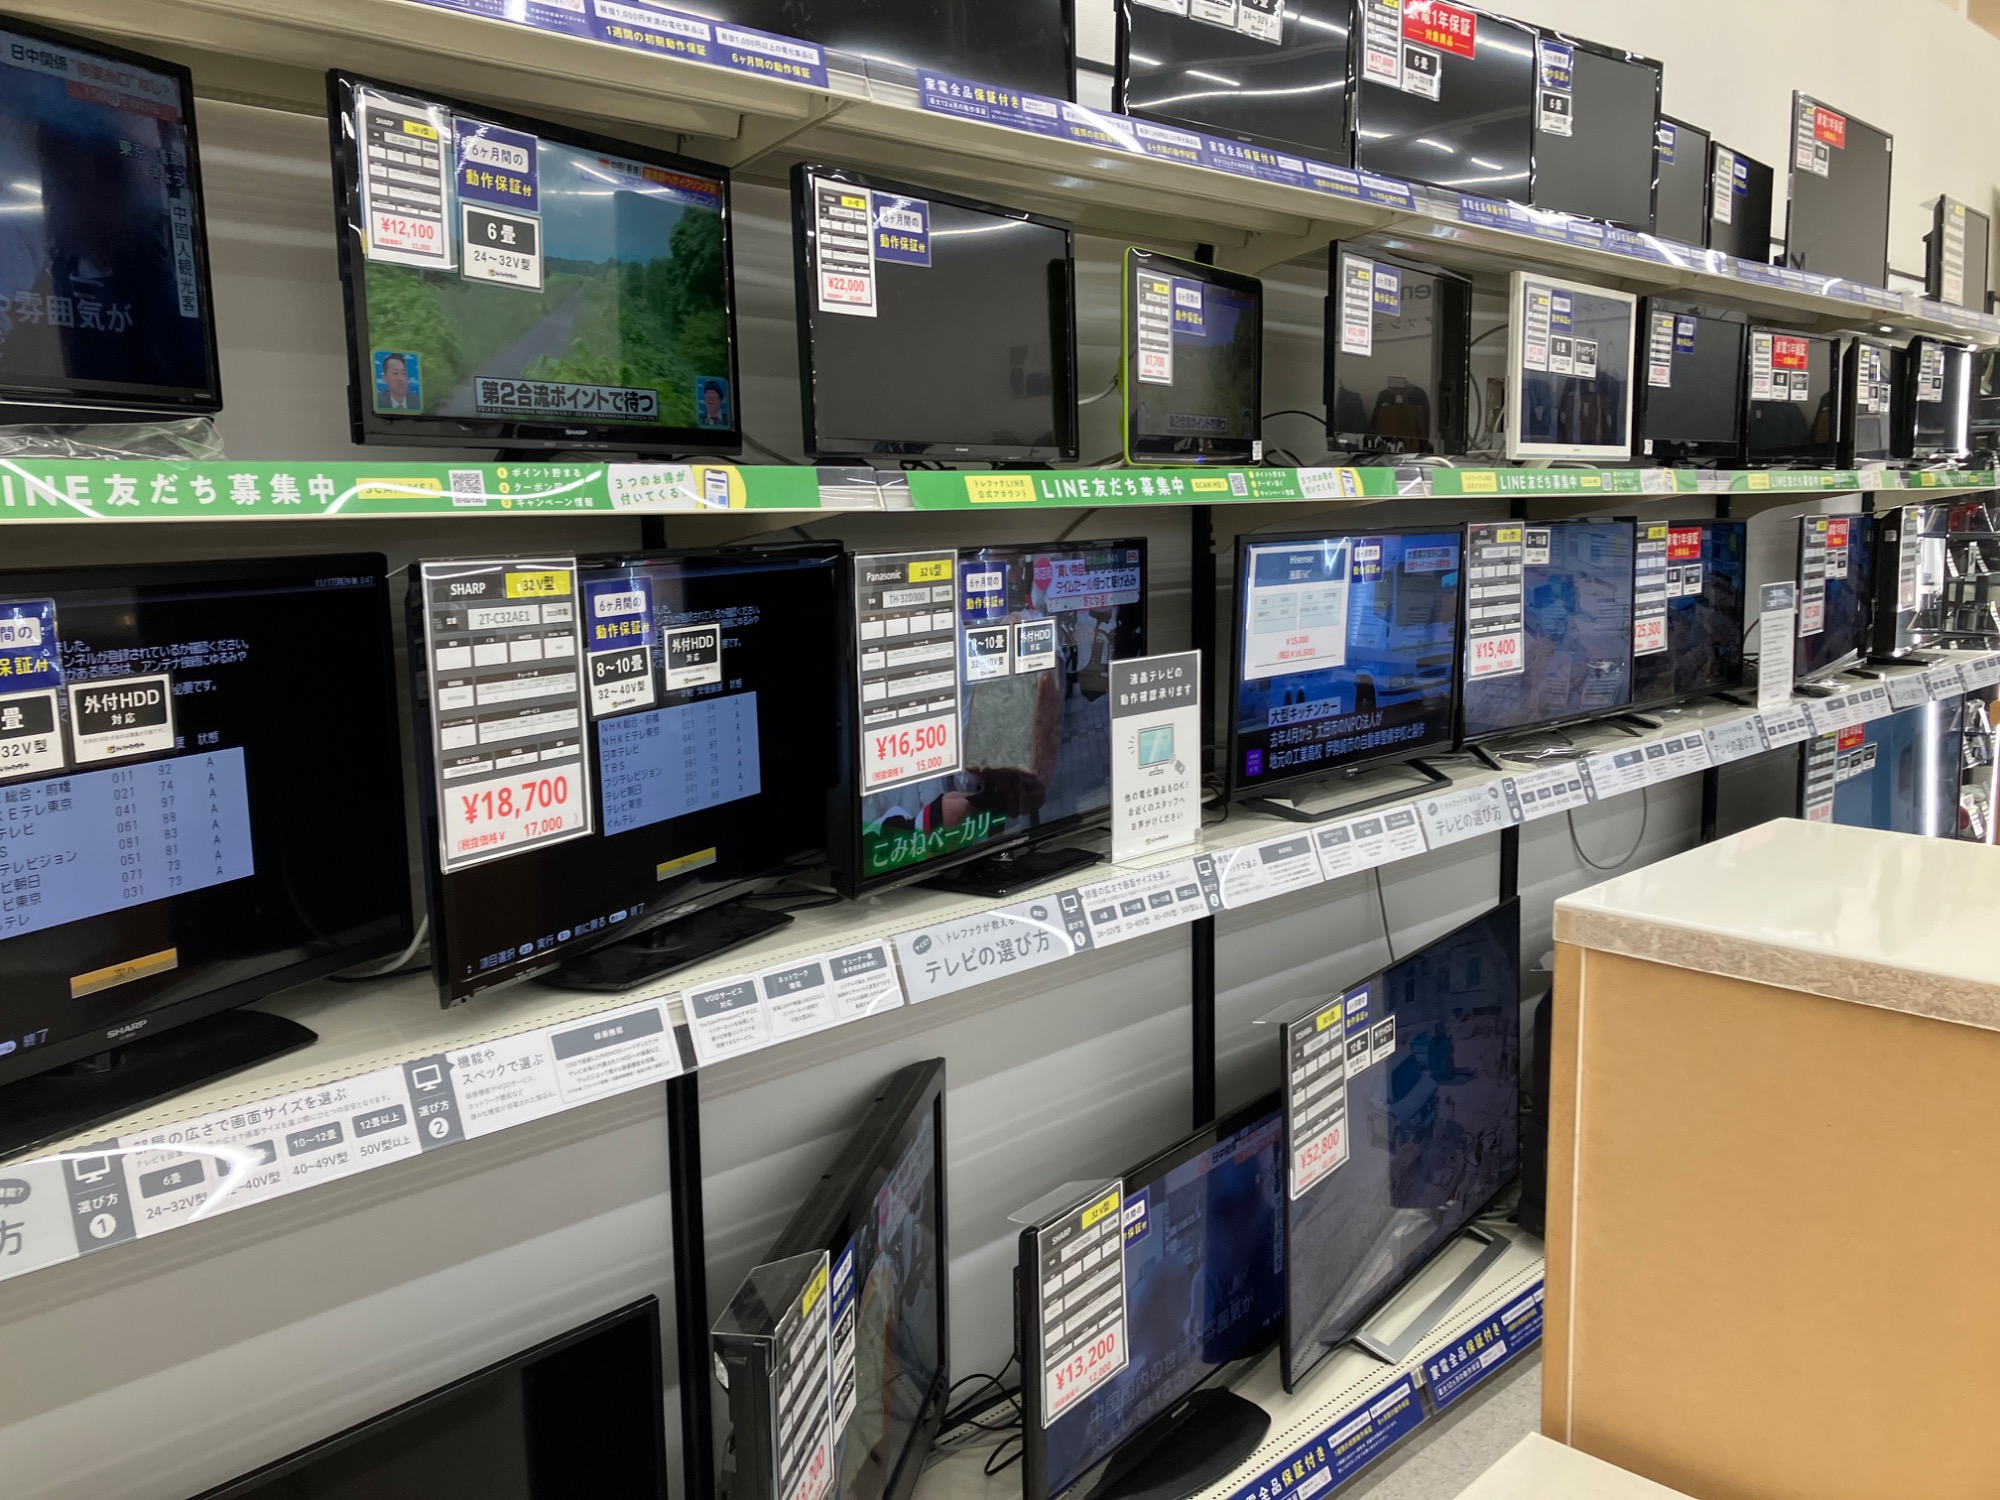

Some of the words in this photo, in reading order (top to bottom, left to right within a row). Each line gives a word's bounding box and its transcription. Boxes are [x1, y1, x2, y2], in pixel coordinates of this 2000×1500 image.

[605, 25, 707, 56] 1週間の初期動作保証
[11, 43, 69, 71] 日中関係
[732, 53, 811, 79] 6ヶ月間の動作保証
[924, 77, 1019, 109] 家電全品保証付き
[472, 143, 524, 167] 6ヶ月間の
[1209, 140, 1276, 166] 家電全品保証付き
[464, 168, 533, 198] 動作保証付
[381, 217, 435, 240] ¥12,100
[486, 222, 517, 246] 6畳
[879, 233, 926, 254] 動作保証付
[172, 204, 197, 314] 中国人観光客
[827, 276, 865, 294] ¥22,000
[481, 380, 654, 413] 第2合流ポイントで待つ
[511, 468, 582, 479] ポイント貯まる
[615, 471, 687, 489] 3つのお得が
[515, 497, 594, 508] キャンペーン情報
[978, 488, 1027, 499] 公式アカウント
[866, 569, 902, 583] Panasonic
[450, 581, 487, 597] SHARP
[598, 597, 642, 613] 6ヶ月間の
[965, 597, 1004, 611] 動作保証付
[477, 612, 532, 627] 2T-C32AE1
[594, 621, 650, 641] 動作保証付
[62, 639, 250, 668] ンネルが登録されているか確認ください。
[671, 635, 715, 654] 外付HDD
[1476, 638, 1516, 659] ¥15,400
[686, 652, 701, 663] 対応
[1129, 667, 1183, 686] 液晶テレビの
[84, 689, 160, 715] 外付HDD
[1120, 684, 1193, 706] 動作確認承ります
[111, 712, 137, 726] 対応
[1270, 703, 1339, 725] 大型キッチンカー
[197, 731, 220, 746] 状態
[1269, 729, 1313, 749] 去年4月から
[1315, 711, 1383, 740] 太田市のNPO法人が
[602, 744, 641, 762] 日本テレビ
[875, 723, 947, 761] ¥16,500
[603, 761, 626, 774] TBS
[915, 755, 943, 773] 15,000
[1268, 744, 1323, 770] 地元の工業高校
[112, 771, 134, 785] 011
[206, 756, 215, 767] A
[604, 766, 663, 789] フジテレビジョン
[113, 787, 136, 801] 021
[207, 772, 216, 783] A
[605, 784, 643, 802] テレビ朝日
[1124, 781, 1190, 803] 他の電化製品もOK!
[115, 804, 137, 818] 041
[208, 788, 217, 798] A
[461, 774, 569, 826] ¥18,700
[1128, 797, 1186, 817] お近くのスタッフへ
[116, 820, 138, 834] 061
[210, 803, 219, 814] A
[523, 814, 564, 838] 17,000
[1131, 812, 1184, 831] お声がけください
[1435, 802, 1502, 838] テレビの選び方
[118, 836, 140, 850] 081
[211, 819, 220, 830] A
[872, 811, 1008, 867] こみねベーカリー
[120, 852, 142, 867] 051
[213, 835, 221, 846] A
[121, 869, 143, 883] 071
[214, 850, 222, 861] A
[123, 885, 145, 900] 031
[216, 865, 224, 876] A
[841, 952, 874, 967] チューナー数
[924, 928, 1051, 985] テレビの選び方
[777, 969, 809, 984] ネットワーク
[703, 987, 744, 1004] VODサービス
[719, 998, 733, 1010] 対応
[106, 1019, 148, 1040] SHARP
[593, 1025, 625, 1042] 録画機能
[456, 1048, 496, 1069] 機能や
[461, 1053, 545, 1087] スペックで選ぶ
[417, 1099, 450, 1118] 選び方
[360, 1112, 401, 1130] 12畳以上
[360, 1135, 412, 1158] 50V型以上
[1300, 1128, 1341, 1170] ¥52,800
[162, 1172, 183, 1187] 6畳
[77, 1192, 120, 1215] 選び方
[1051, 1226, 1072, 1246] SHARP
[1054, 1332, 1116, 1391] ¥13,200
[1429, 1322, 1501, 1381] 家電全品保証付き
